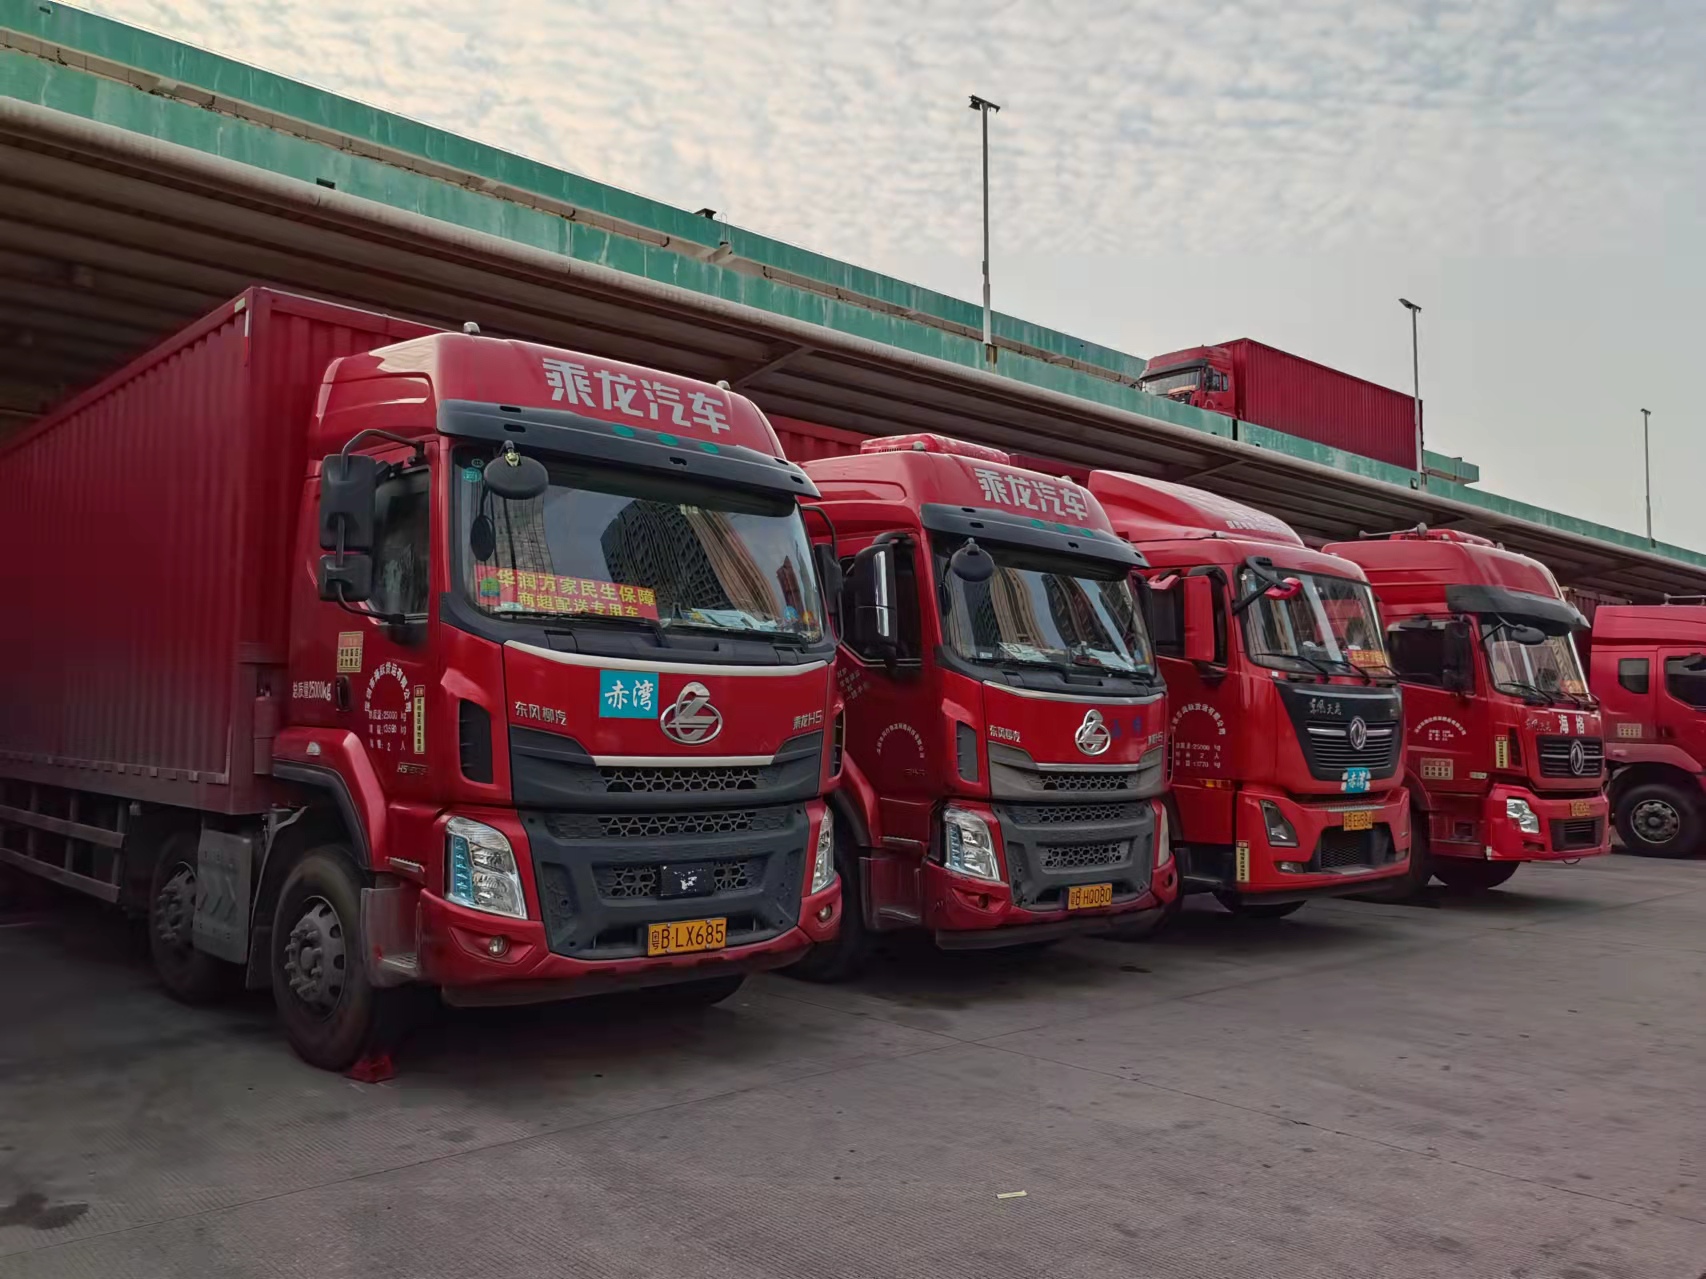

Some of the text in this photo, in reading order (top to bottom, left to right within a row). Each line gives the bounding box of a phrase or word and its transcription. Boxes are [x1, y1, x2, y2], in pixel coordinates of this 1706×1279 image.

[543, 358, 730, 434] 乘龙汽车
[974, 468, 1088, 521] 乘龙汽车
[497, 569, 656, 606] 华润万家民生保障
[518, 592, 639, 617] 商超配送专用车
[604, 679, 655, 712] 赤湾
[515, 701, 568, 726] 东风柳汽
